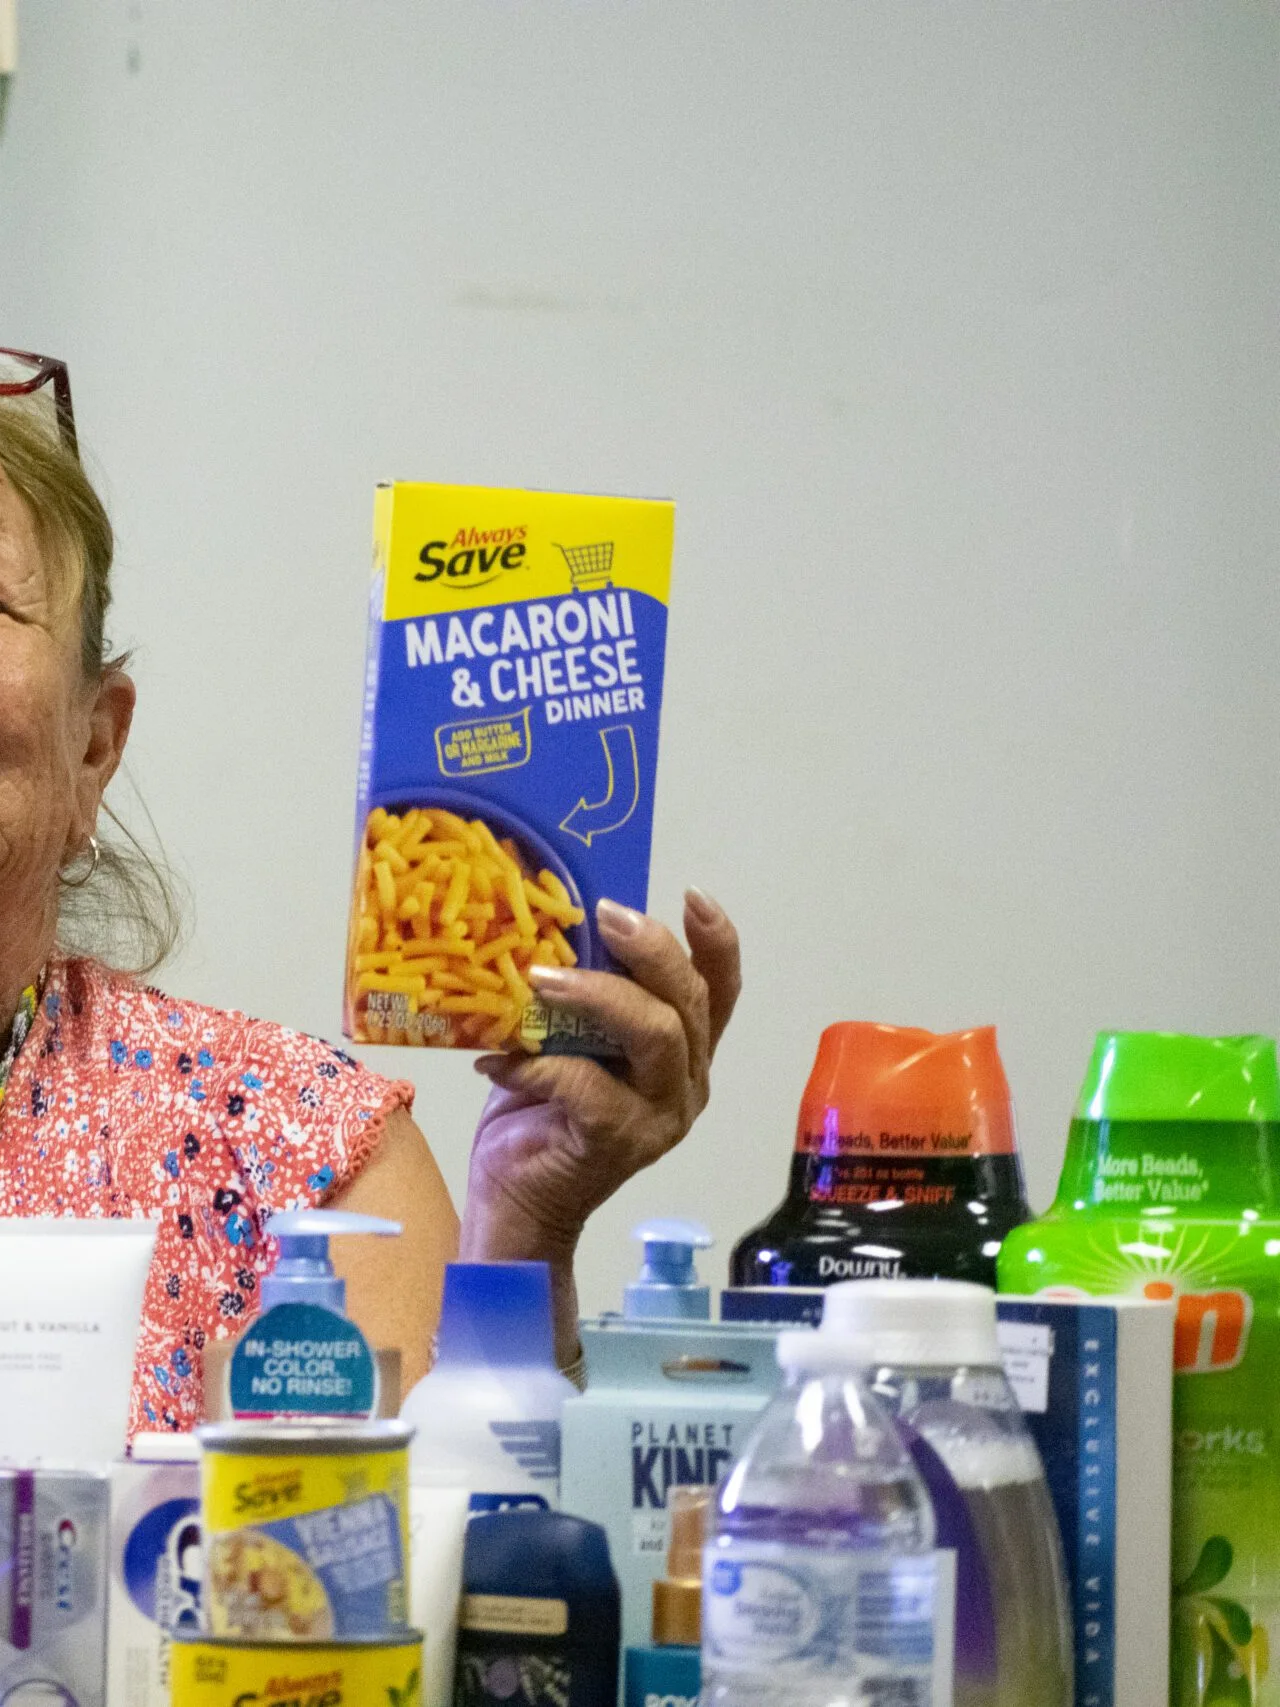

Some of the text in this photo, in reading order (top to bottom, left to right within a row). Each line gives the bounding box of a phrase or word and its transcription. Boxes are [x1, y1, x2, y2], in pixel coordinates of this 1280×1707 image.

[451, 524, 529, 549] Always
[413, 540, 527, 583] Save
[405, 591, 635, 669] MACARONI
[450, 639, 643, 709] & CHEESE
[544, 687, 646, 725] DINNER
[879, 1132, 927, 1149] Better
[819, 1255, 900, 1281] Downy
[24, 1321, 33, 1332] &
[37, 1321, 102, 1333] VANILLA
[245, 1340, 360, 1358] IN-SHOWER
[251, 1377, 352, 1396] NO RINSE!
[631, 1421, 734, 1446] PLANET
